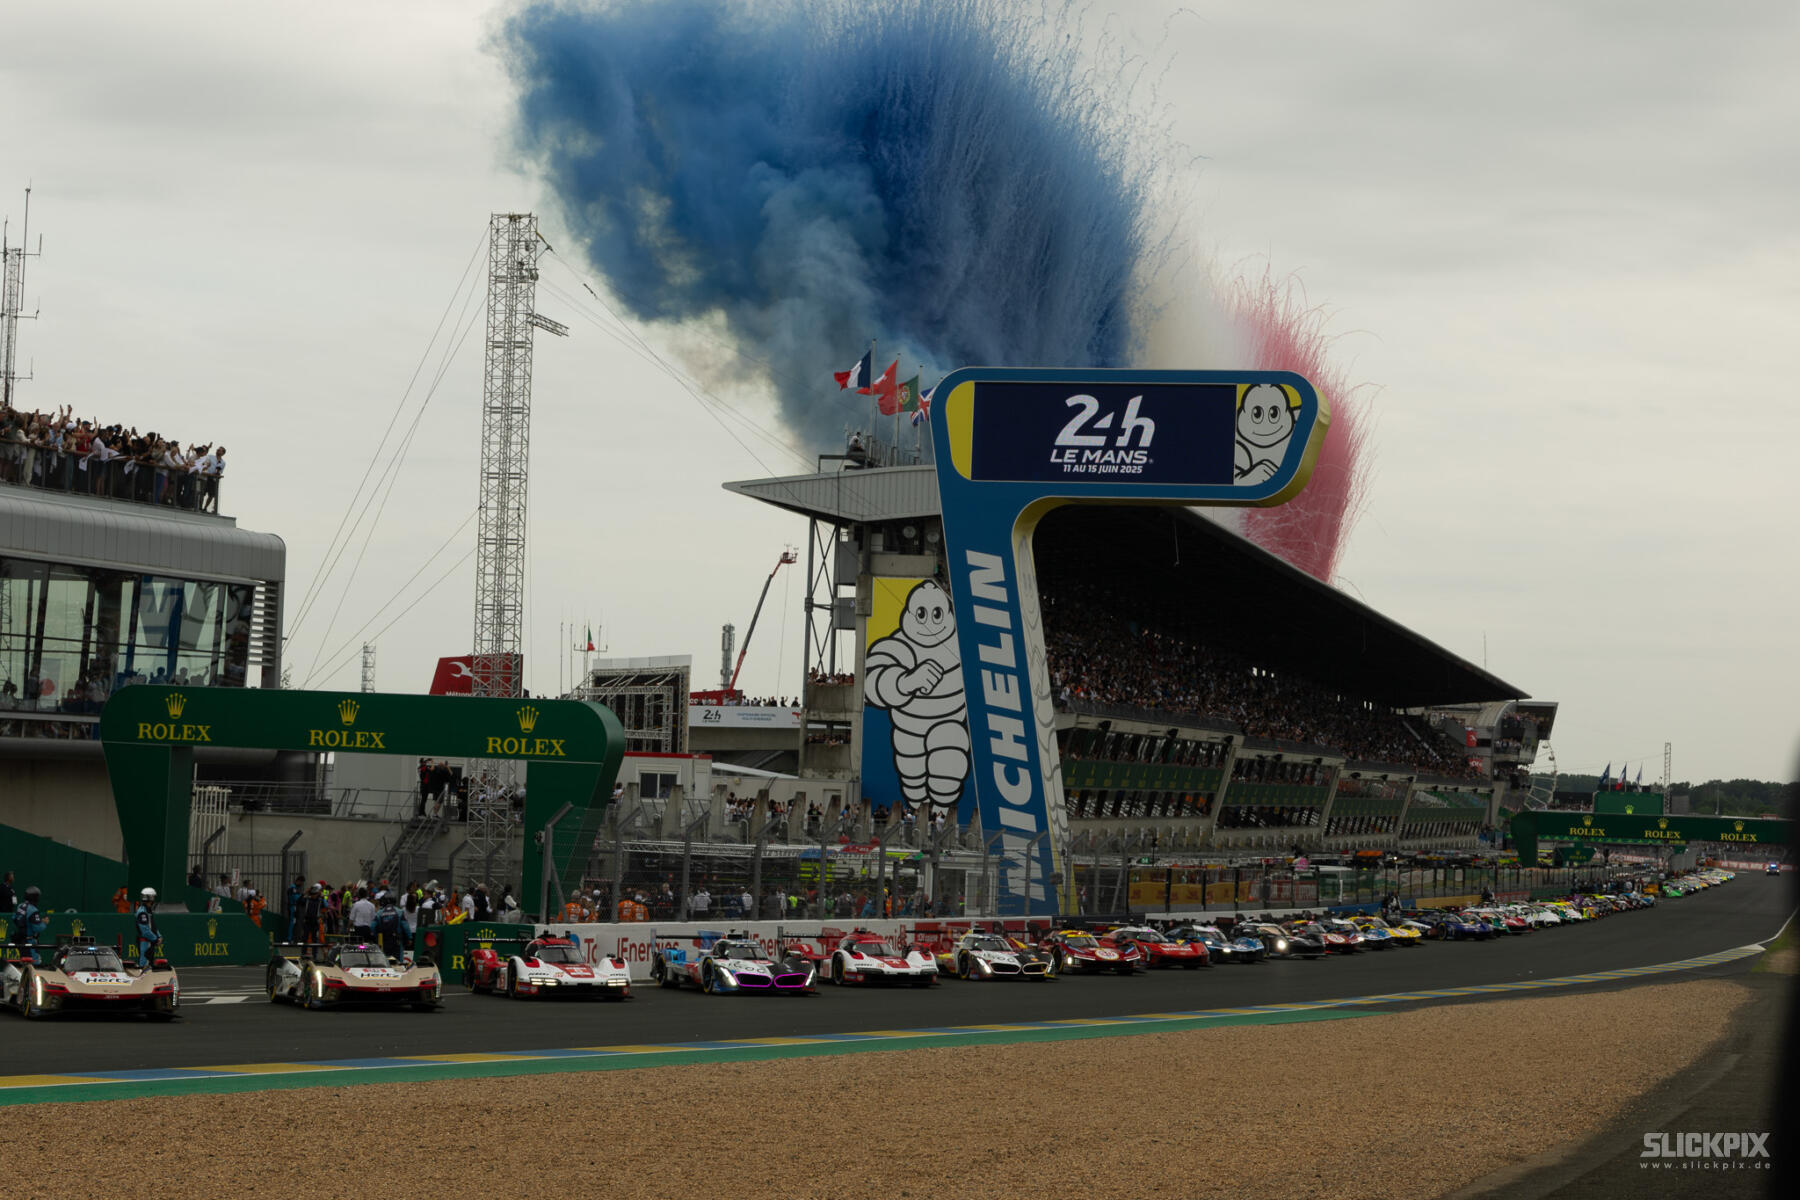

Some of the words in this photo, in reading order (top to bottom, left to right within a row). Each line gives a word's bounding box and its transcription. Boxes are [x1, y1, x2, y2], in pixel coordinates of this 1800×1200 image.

[1055, 394, 1156, 447] 24h
[1050, 449, 1079, 462] LE
[1081, 450, 1149, 464] MANS
[1098, 465, 1119, 474] JUIN
[1120, 465, 1143, 474] 2025
[137, 723, 212, 741] ROLEX
[965, 549, 1046, 902] MICHELIN
[308, 729, 386, 749] ROLEX
[486, 736, 566, 756] ROLEX
[1570, 827, 1606, 837] ROLEX
[1645, 830, 1681, 840] ROLEX
[1720, 833, 1757, 843] ROLEX
[194, 942, 228, 957] ROLEX
